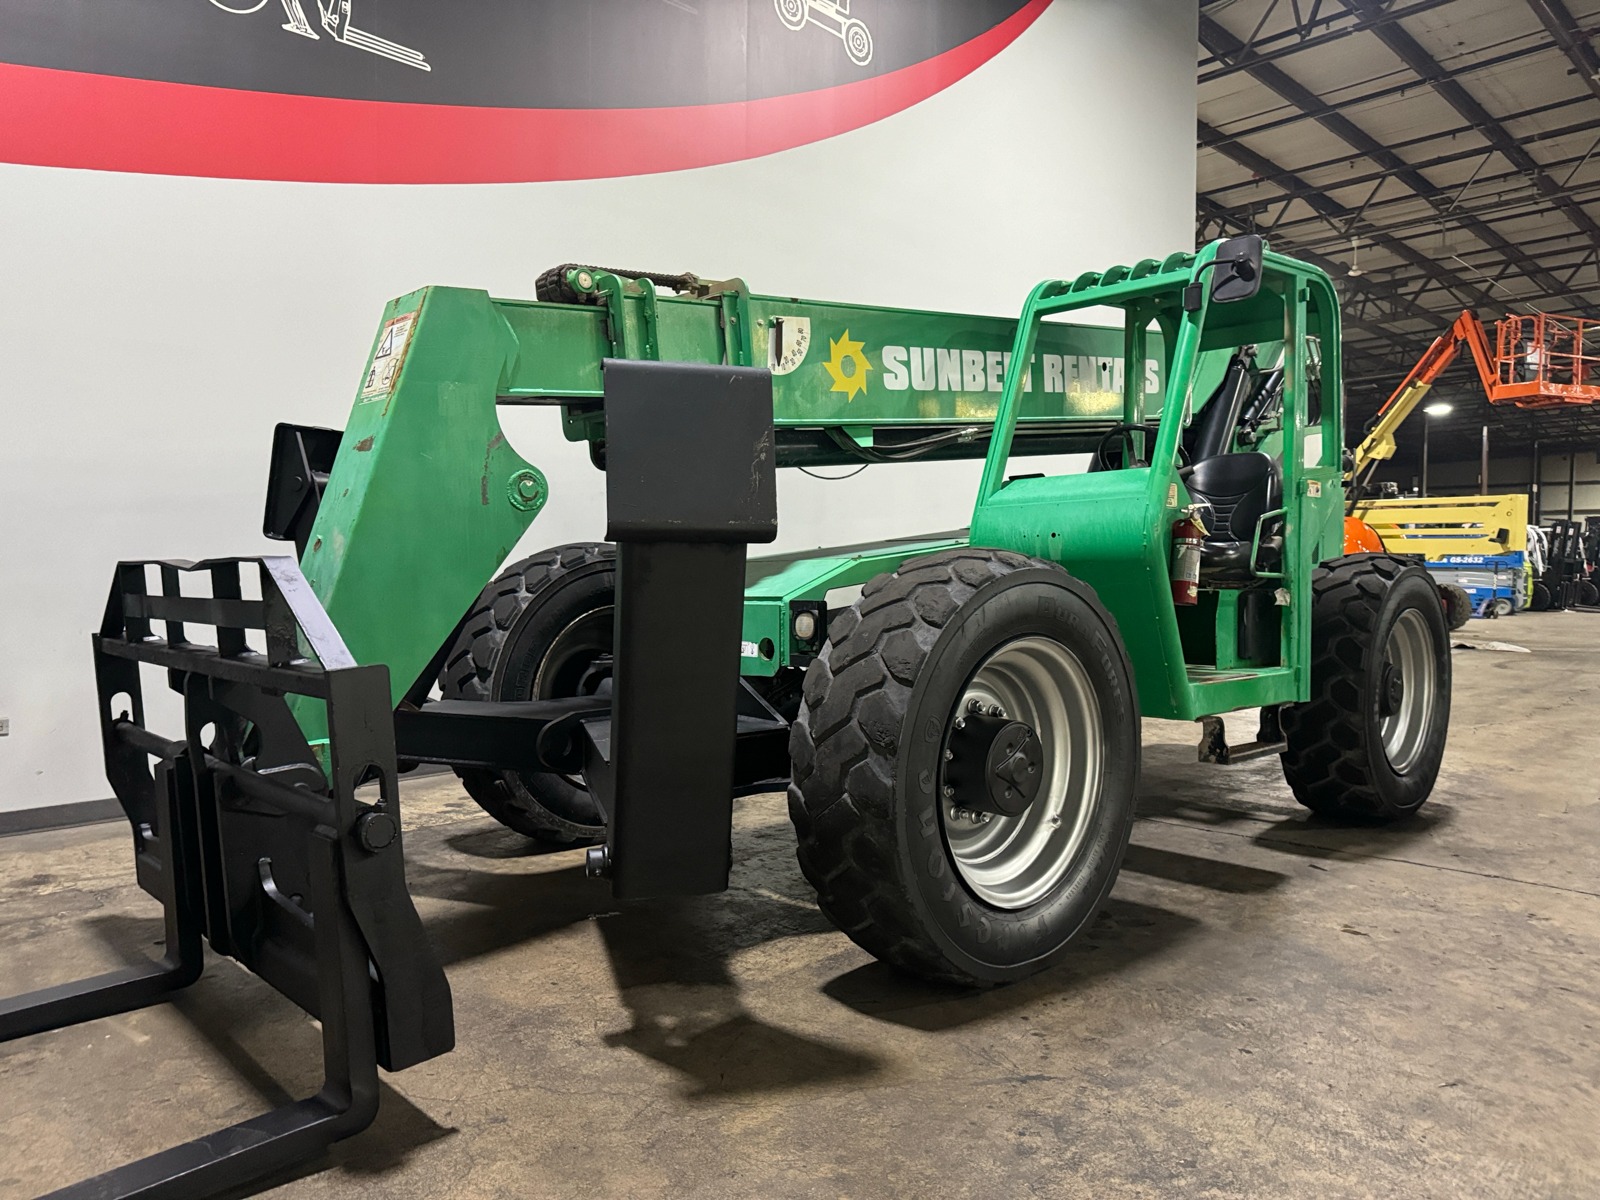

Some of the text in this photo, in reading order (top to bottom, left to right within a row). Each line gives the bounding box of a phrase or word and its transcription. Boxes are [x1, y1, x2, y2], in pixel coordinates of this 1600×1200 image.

[882, 345, 1159, 394] SUNBE RENTAS
[1450, 556, 1484, 564] GS-2632
